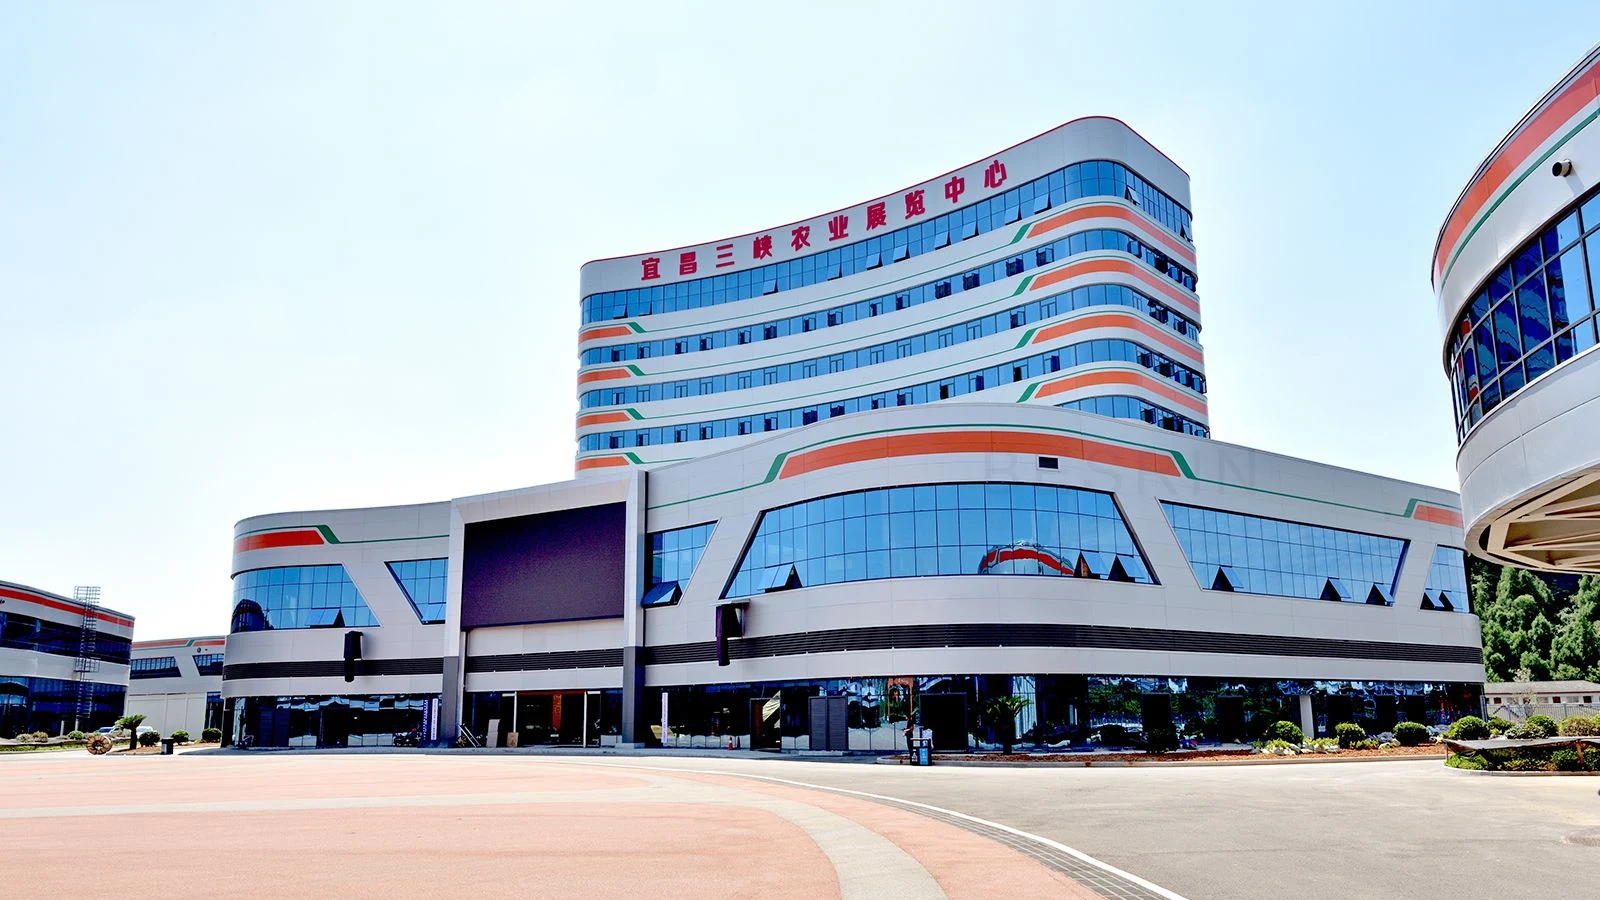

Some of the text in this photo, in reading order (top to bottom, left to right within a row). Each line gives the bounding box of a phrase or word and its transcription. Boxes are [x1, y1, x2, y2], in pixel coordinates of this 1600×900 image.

[641, 159, 1007, 281] 宜昌三峡农业展览中心
